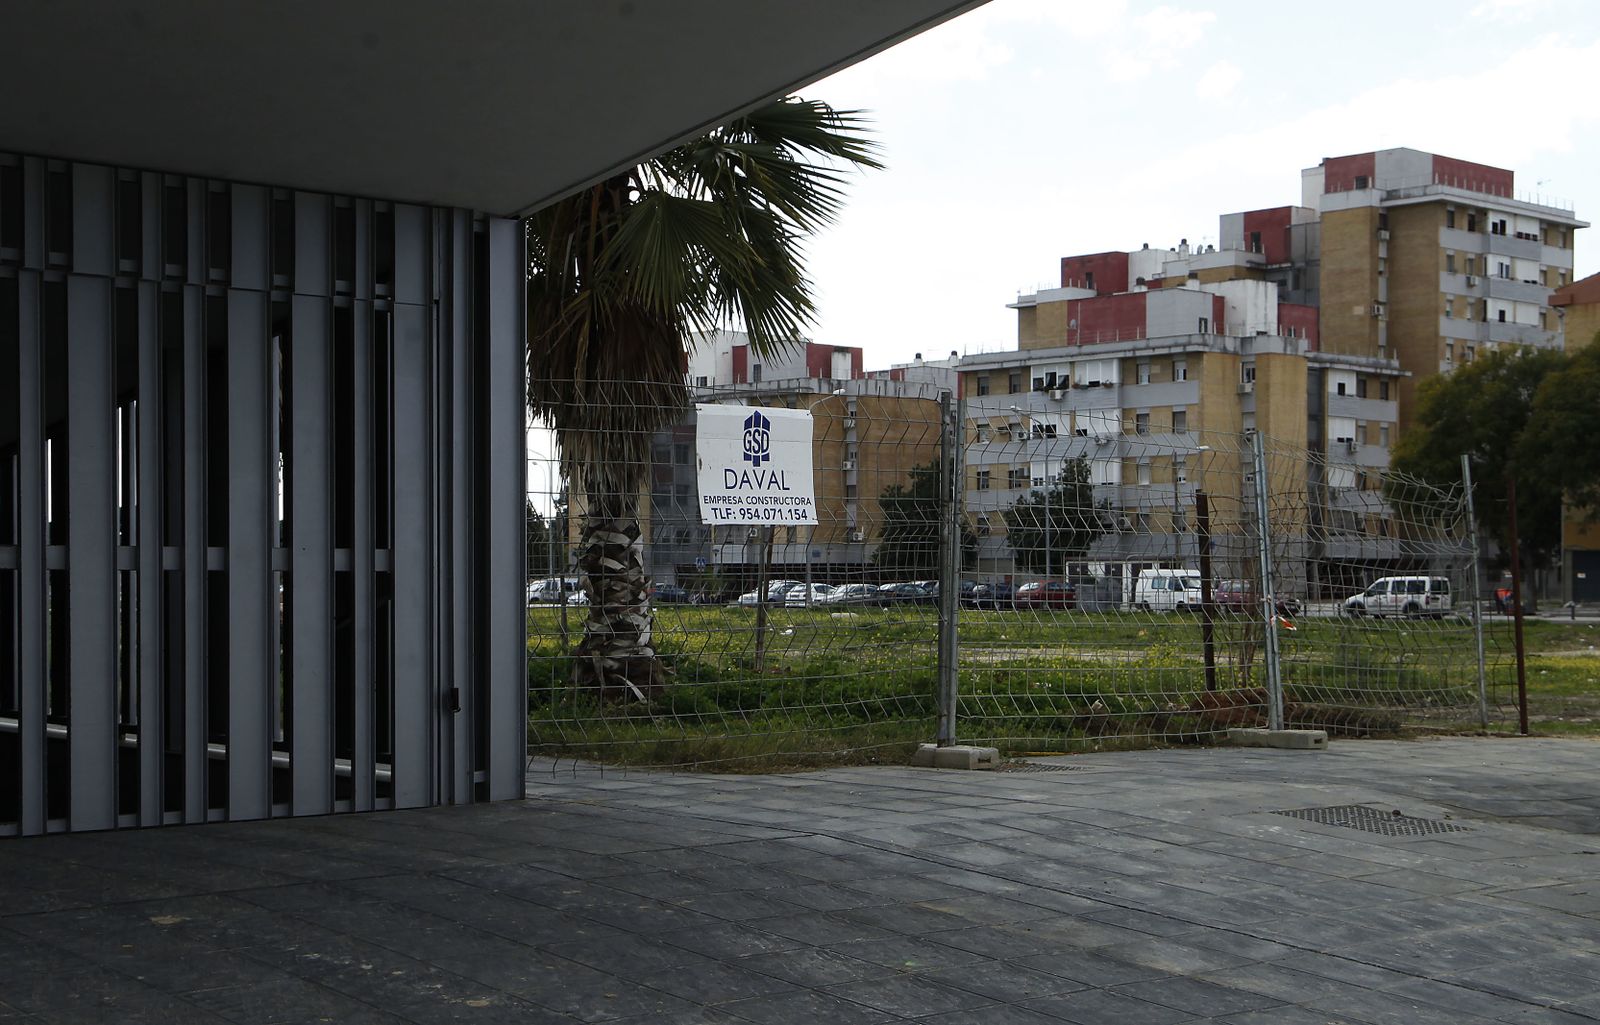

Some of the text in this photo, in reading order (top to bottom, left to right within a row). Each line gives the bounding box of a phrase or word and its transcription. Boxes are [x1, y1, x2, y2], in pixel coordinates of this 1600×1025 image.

[743, 428, 770, 455] GSD
[724, 468, 790, 490] DAVAL
[703, 495, 812, 506] EMPRESA CONSTRUCTORA
[711, 507, 808, 521] TLF: 954.071.154
